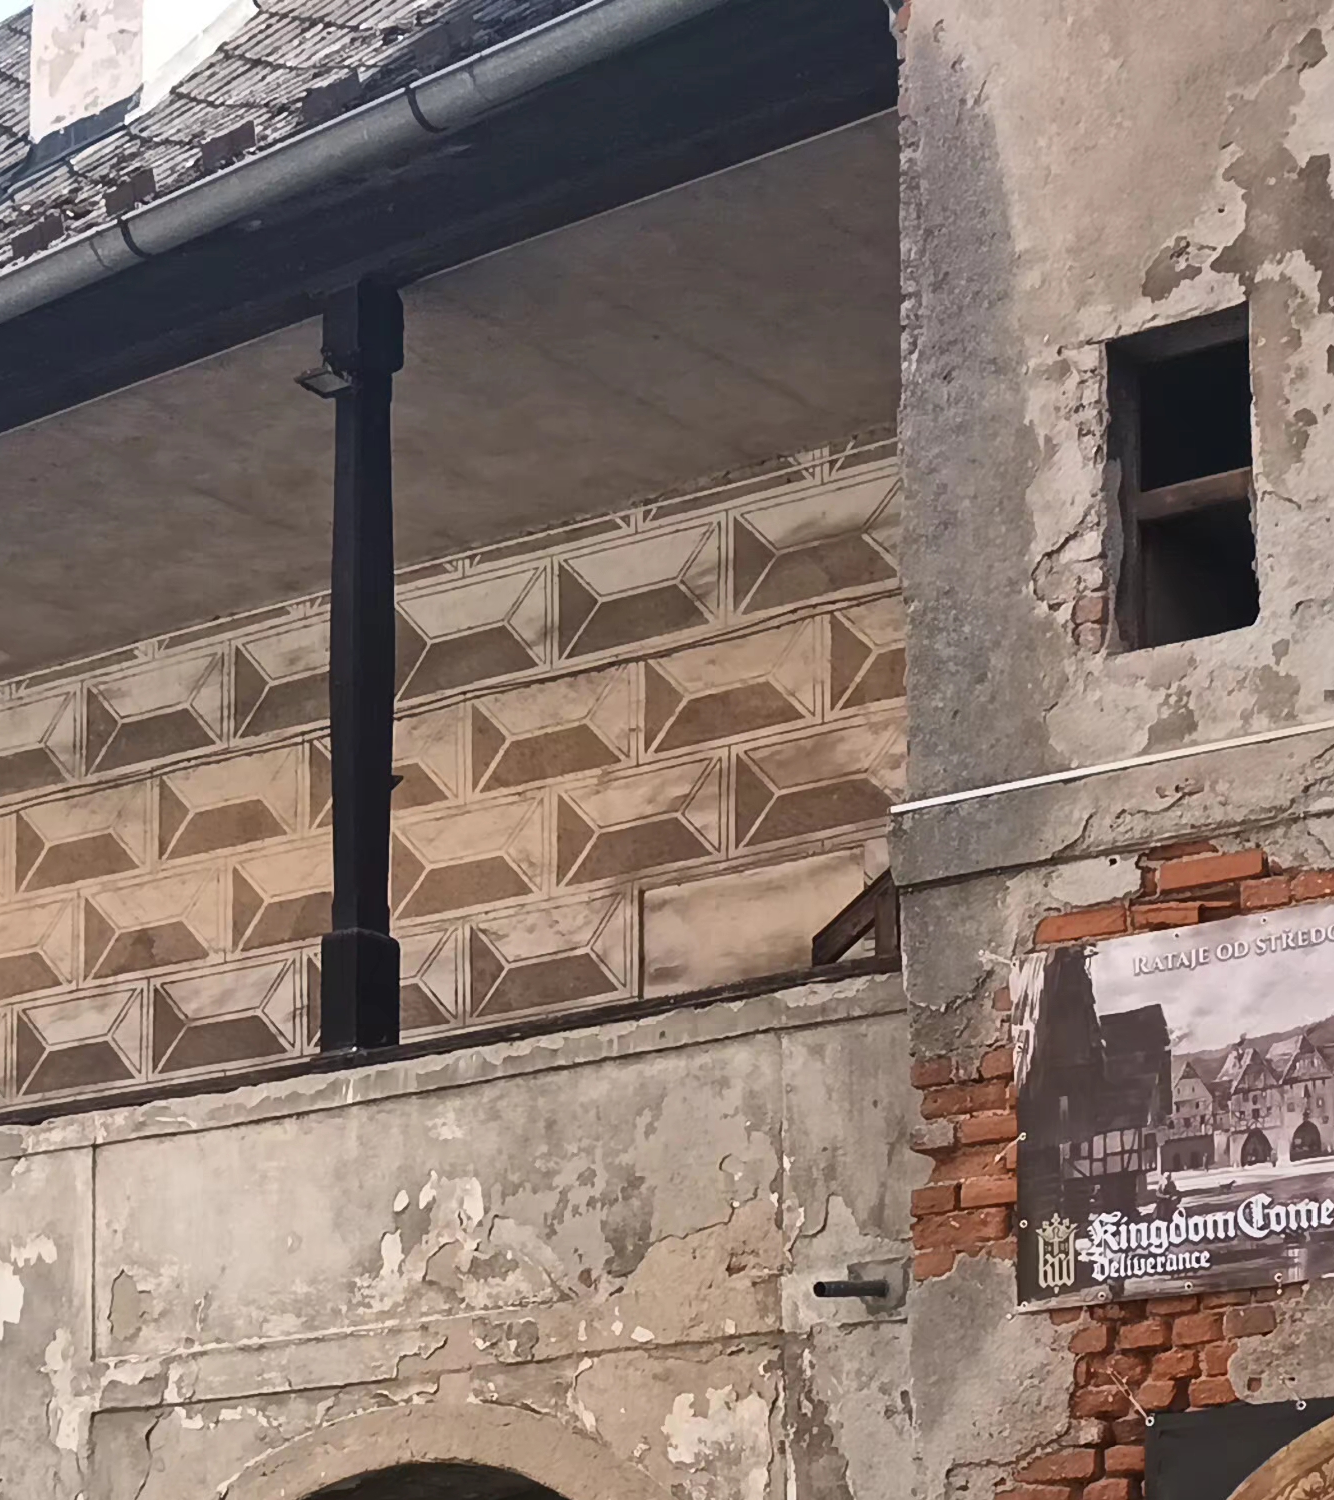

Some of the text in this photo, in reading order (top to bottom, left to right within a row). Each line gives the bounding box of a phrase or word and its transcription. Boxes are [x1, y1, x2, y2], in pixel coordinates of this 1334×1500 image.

[1133, 946, 1209, 976] RATAJE
[1215, 940, 1249, 962] OD
[1088, 1208, 1236, 1255] Kingdom
[1091, 1249, 1211, 1281] Deliverance
